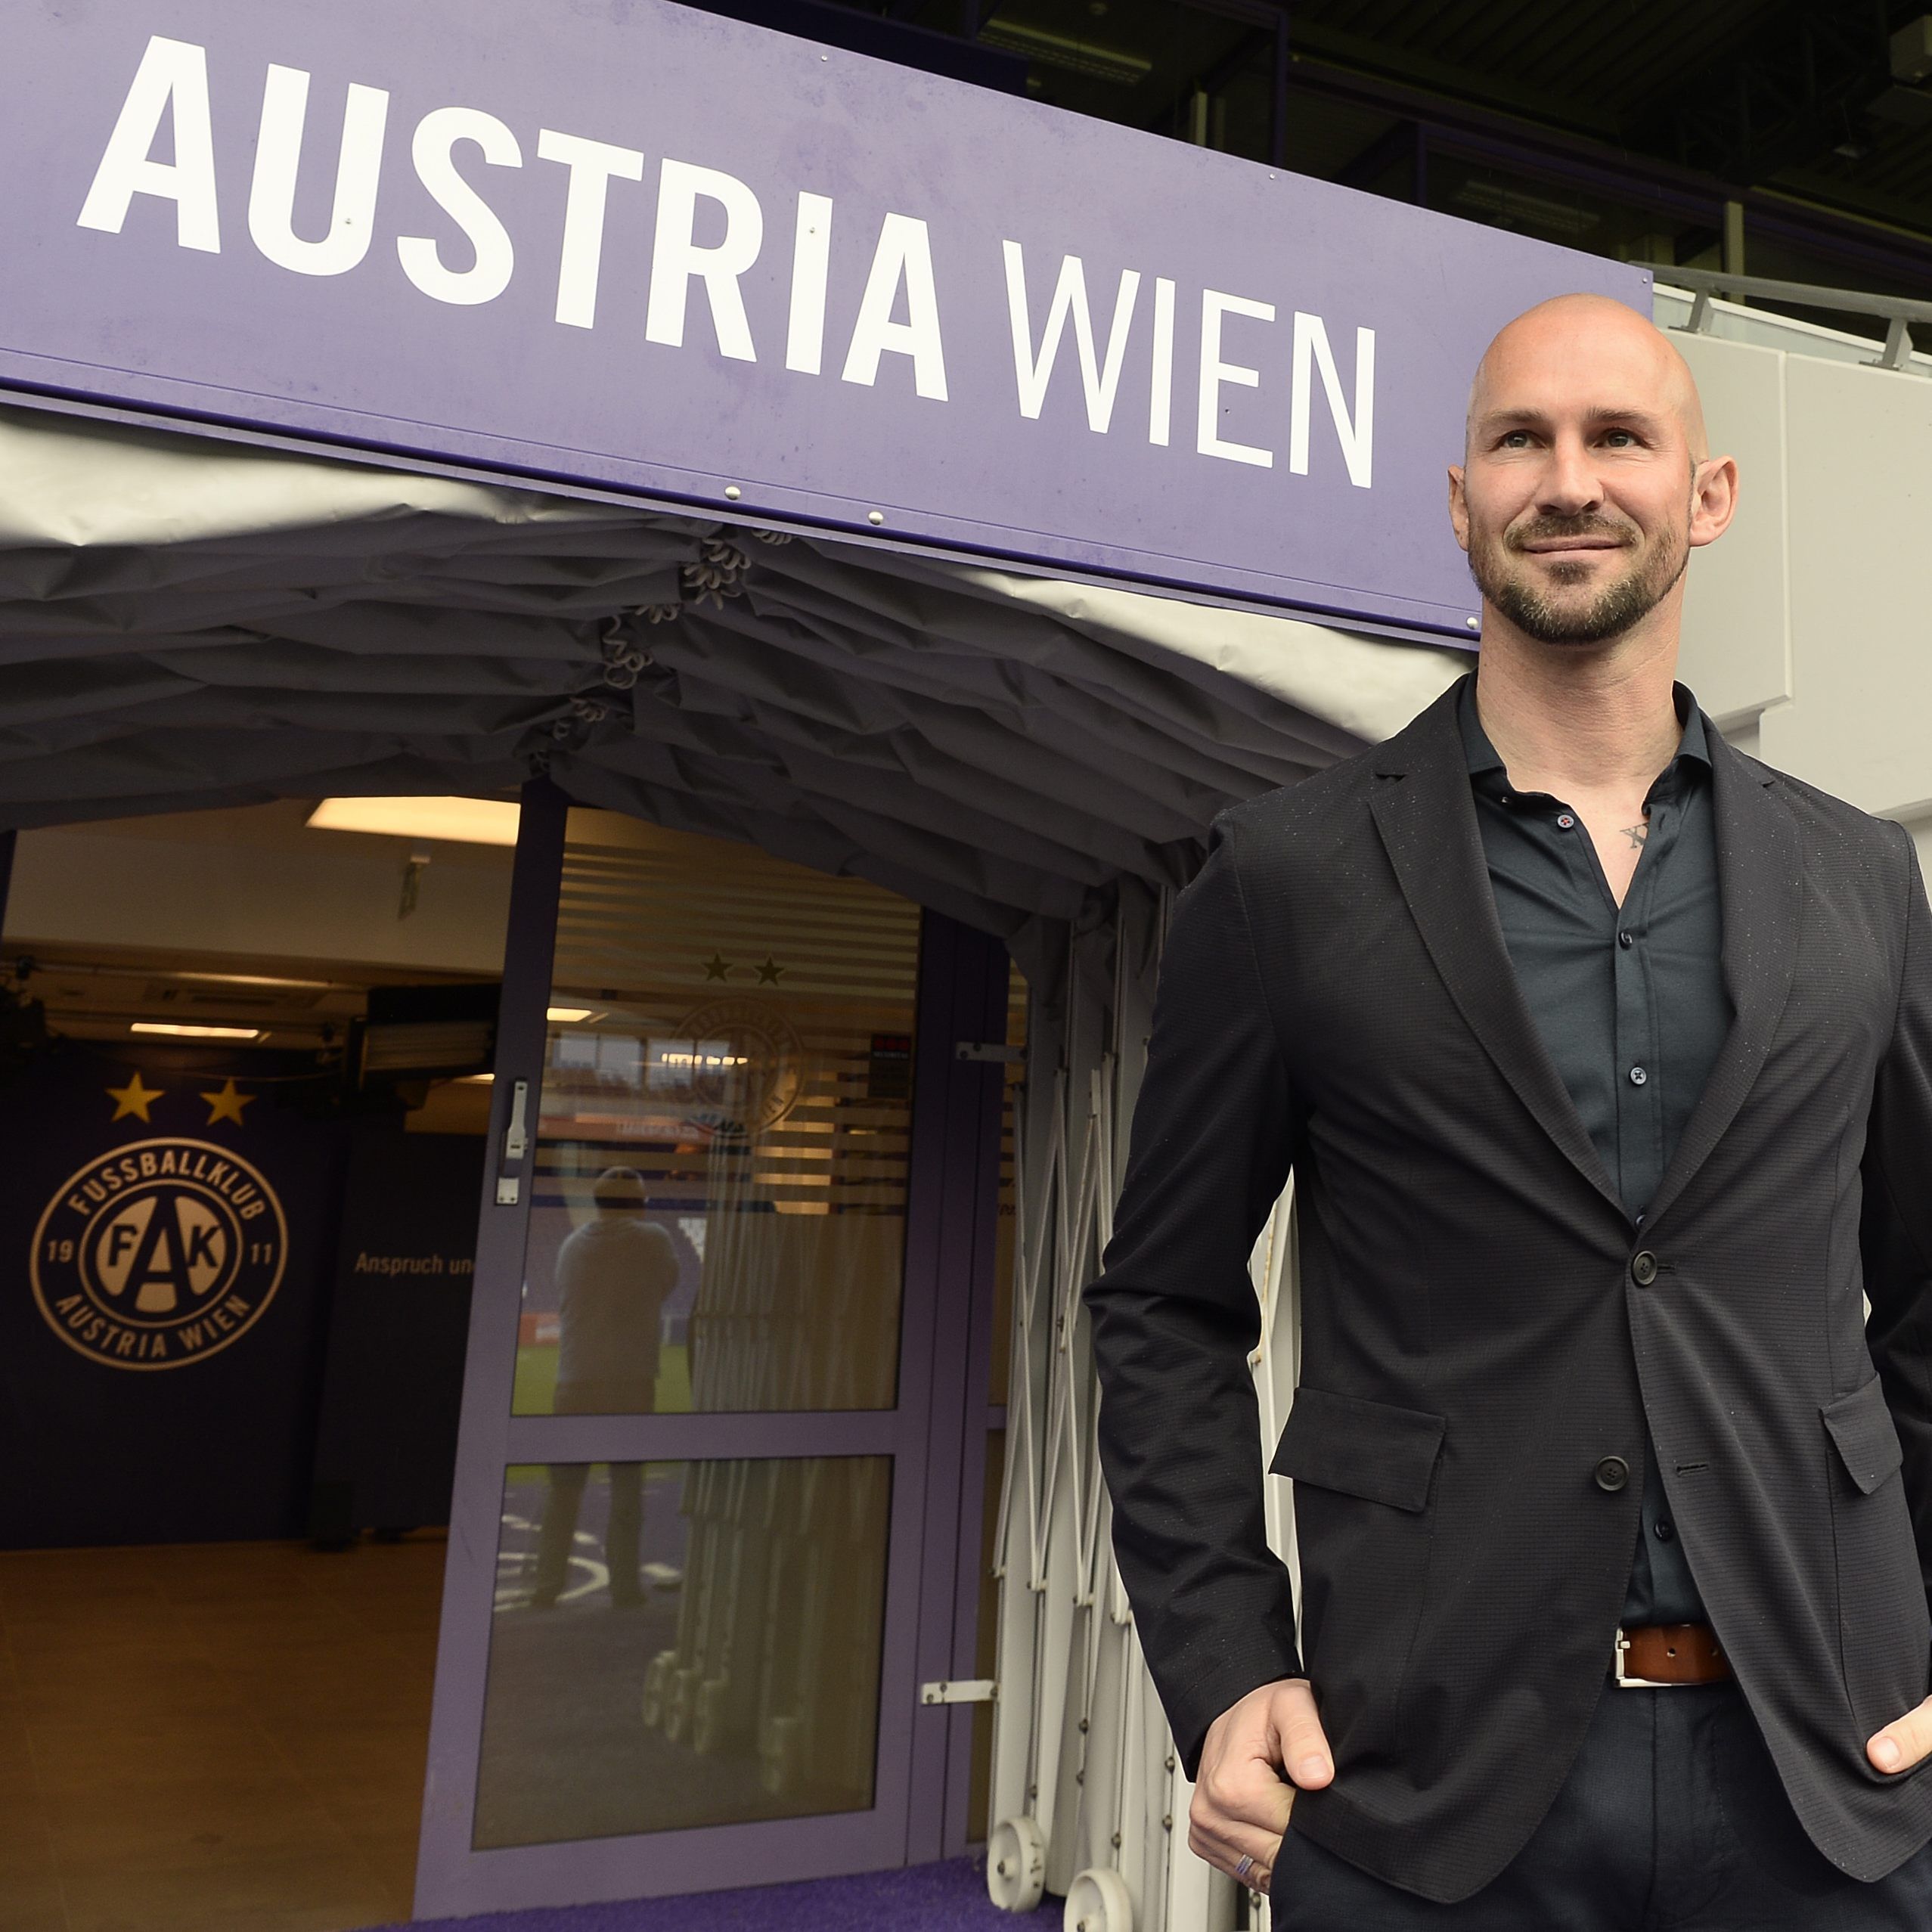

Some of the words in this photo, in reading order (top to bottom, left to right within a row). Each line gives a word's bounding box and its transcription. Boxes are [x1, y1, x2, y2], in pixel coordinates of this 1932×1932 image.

[76, 34, 950, 403] AUSTRIA
[1002, 240, 1377, 490] WIEN
[67, 1149, 268, 1221] FUSSBALLKLUB
[47, 1239, 75, 1265] 19
[250, 1241, 273, 1266] 11
[355, 1250, 443, 1278] Anspruch
[448, 1258, 476, 1276] un
[55, 1292, 168, 1360] AUSTRIA
[176, 1292, 252, 1352] WIEN
